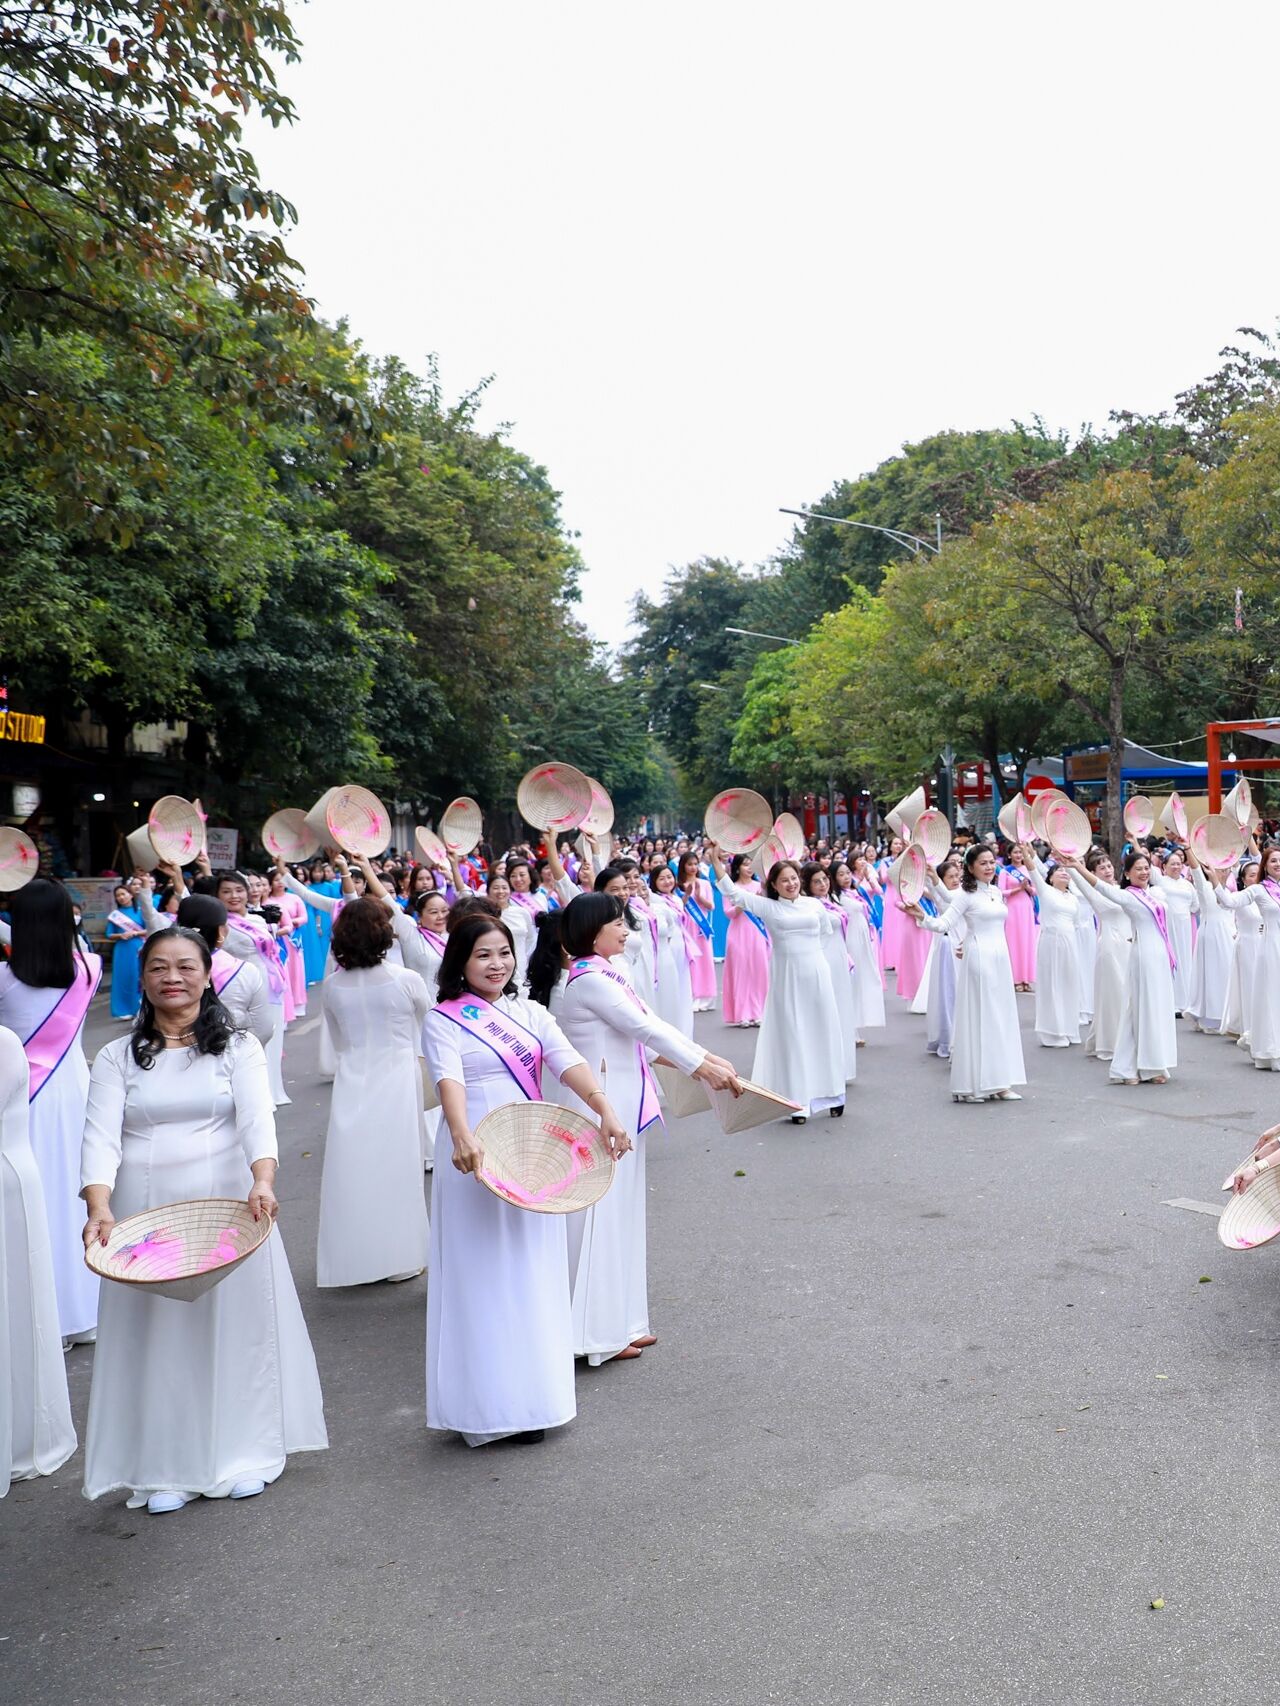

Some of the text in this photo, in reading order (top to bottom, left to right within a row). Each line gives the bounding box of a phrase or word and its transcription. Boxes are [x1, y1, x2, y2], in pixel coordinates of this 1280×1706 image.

[6, 710, 46, 744] STUDIO
[484, 1021, 504, 1038] PHỤ
[498, 1032, 517, 1044] NỮ
[509, 1040, 530, 1057] THỦ
[520, 1052, 536, 1067] ĐÔ
